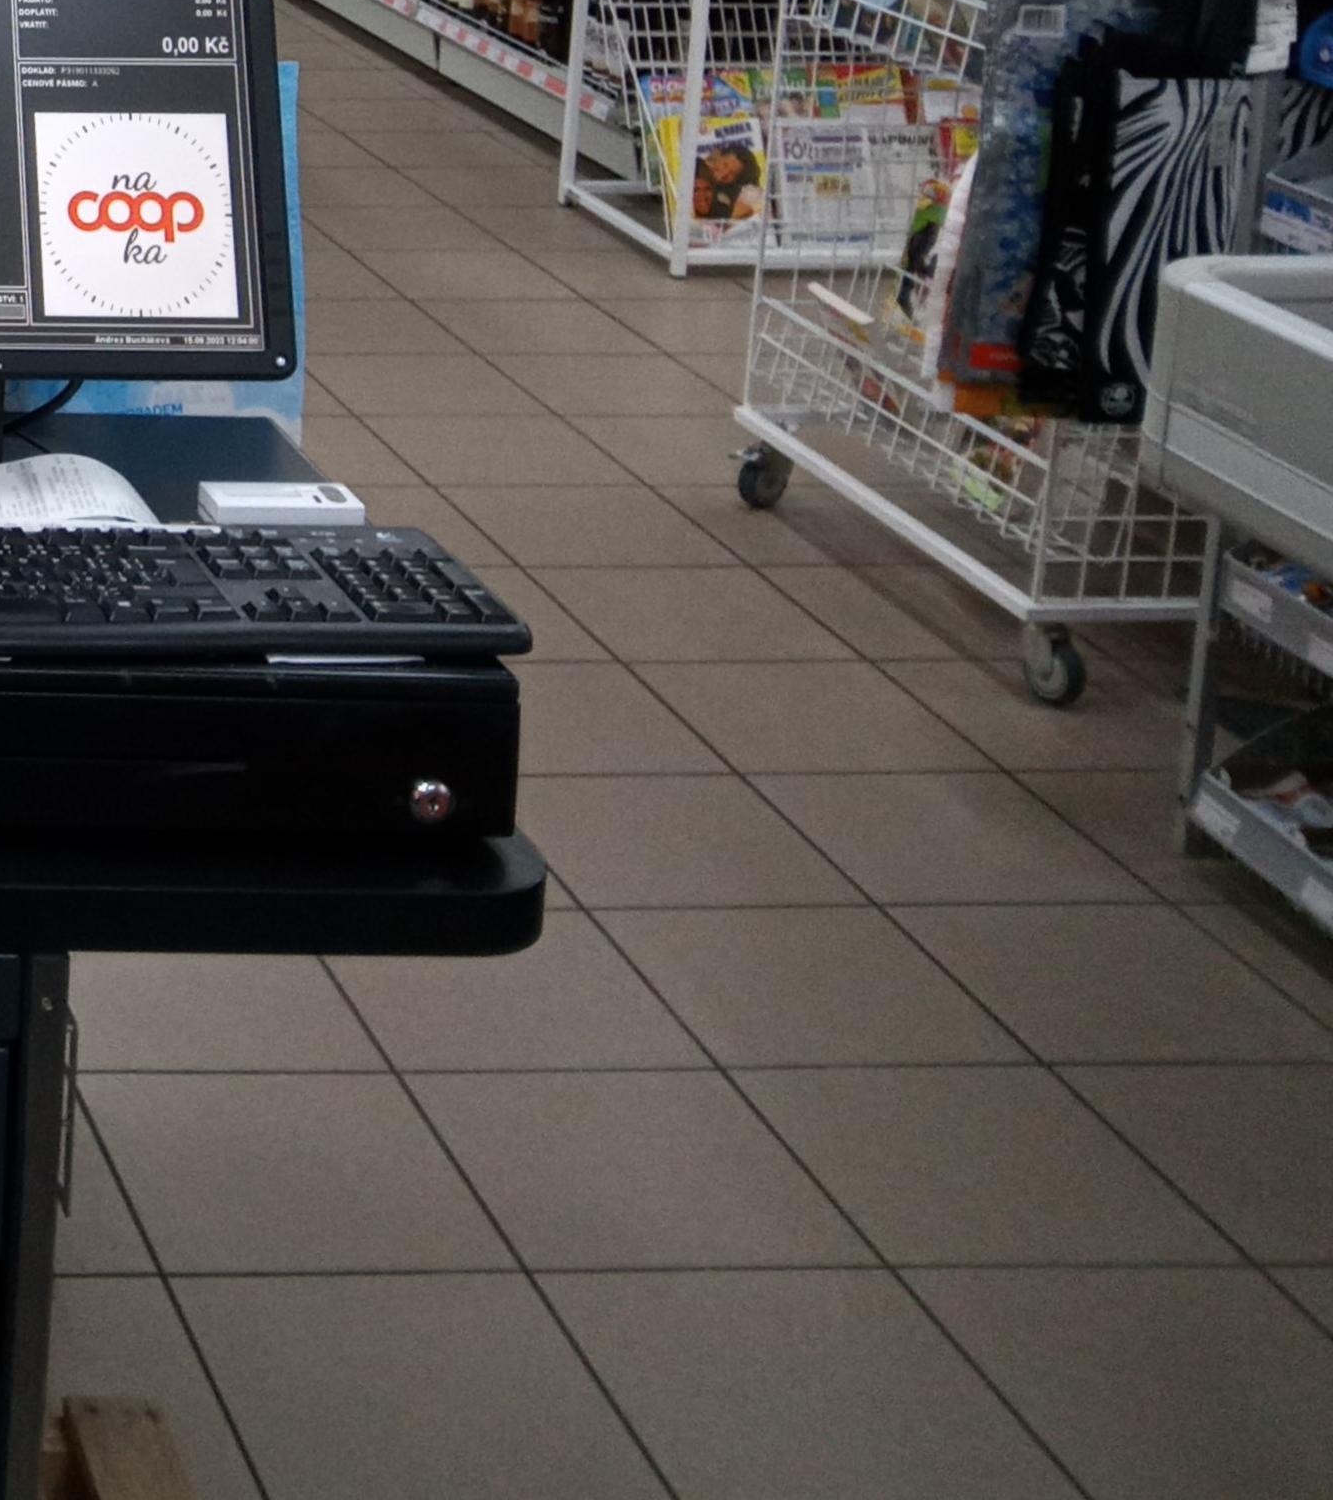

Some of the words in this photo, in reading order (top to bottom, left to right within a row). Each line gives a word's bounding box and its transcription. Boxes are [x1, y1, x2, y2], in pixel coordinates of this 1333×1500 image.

[161, 36, 199, 56] 0,00
[205, 36, 229, 54] Kč
[112, 171, 157, 192] na
[68, 190, 205, 243] coop
[123, 228, 168, 265] ka
